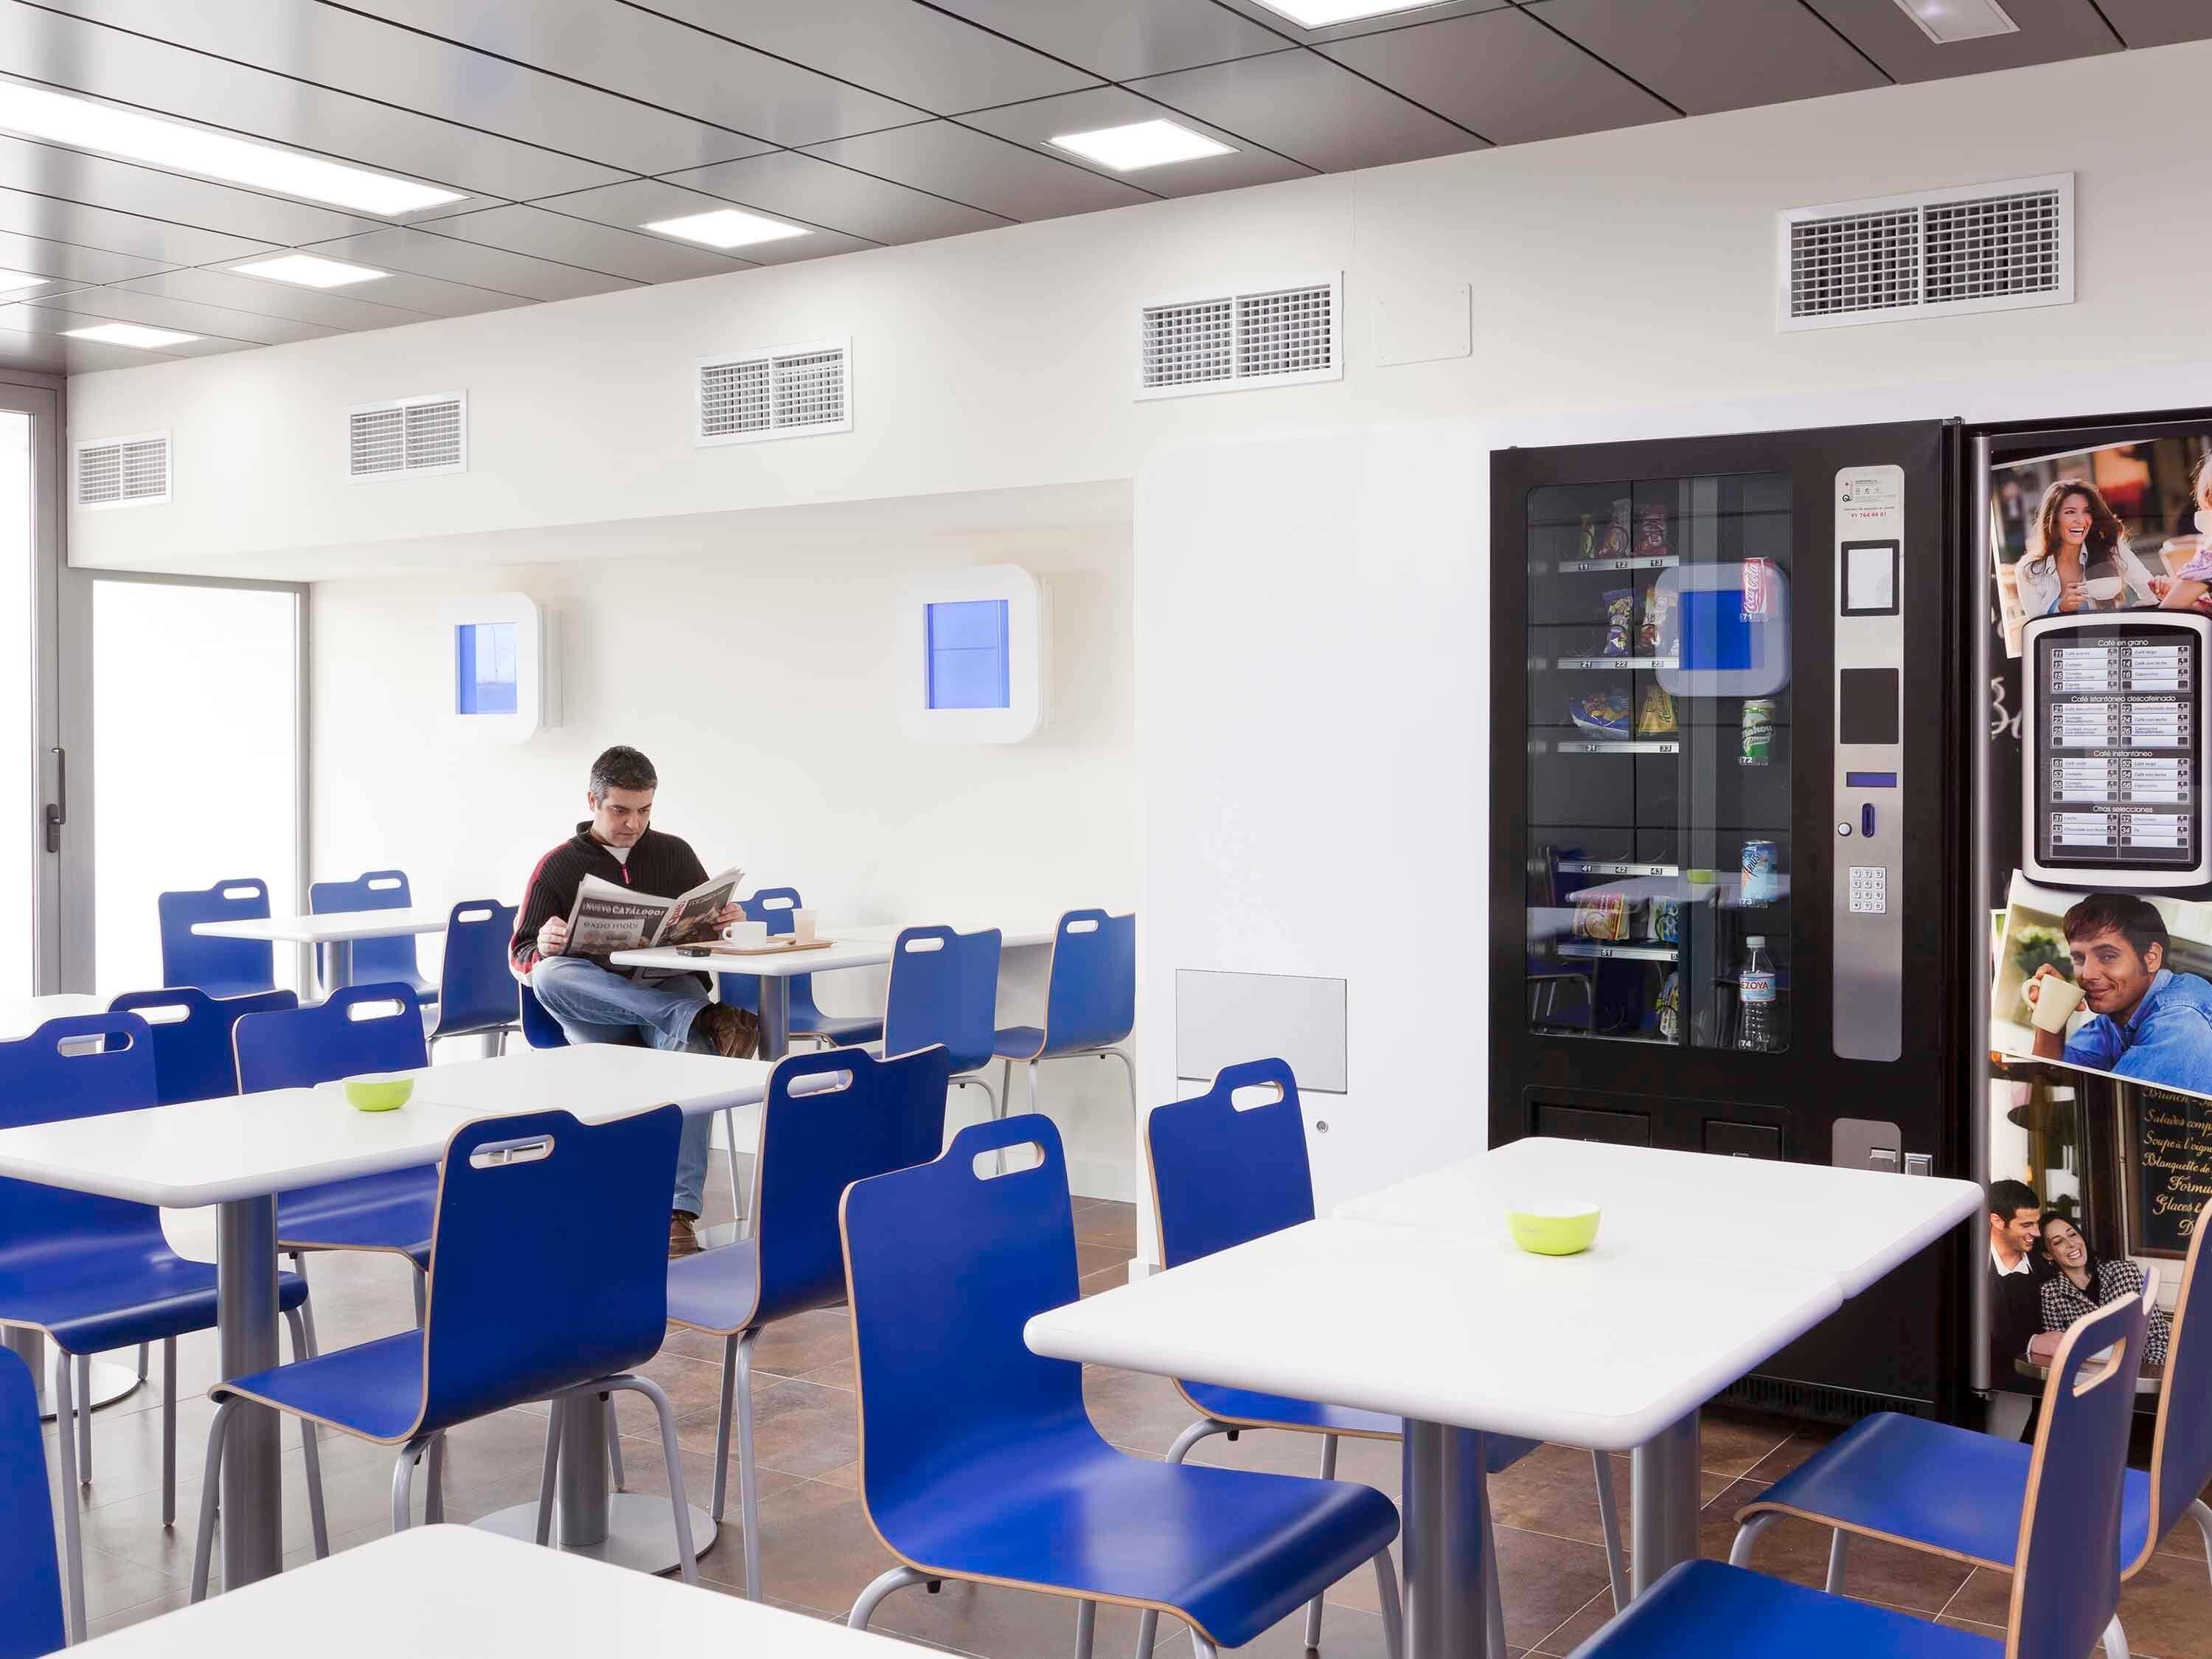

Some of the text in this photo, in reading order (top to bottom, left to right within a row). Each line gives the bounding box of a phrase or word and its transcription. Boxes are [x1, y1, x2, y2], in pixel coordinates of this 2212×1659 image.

[2093, 750, 2112, 758] Café
[1741, 897, 1753, 905] 73
[1739, 981, 1769, 990] EZOYA
[2143, 1130, 2175, 1153] Soupe
[2142, 1152, 2211, 1174] Blanquette de
[2153, 1194, 2192, 1214] Glaces
